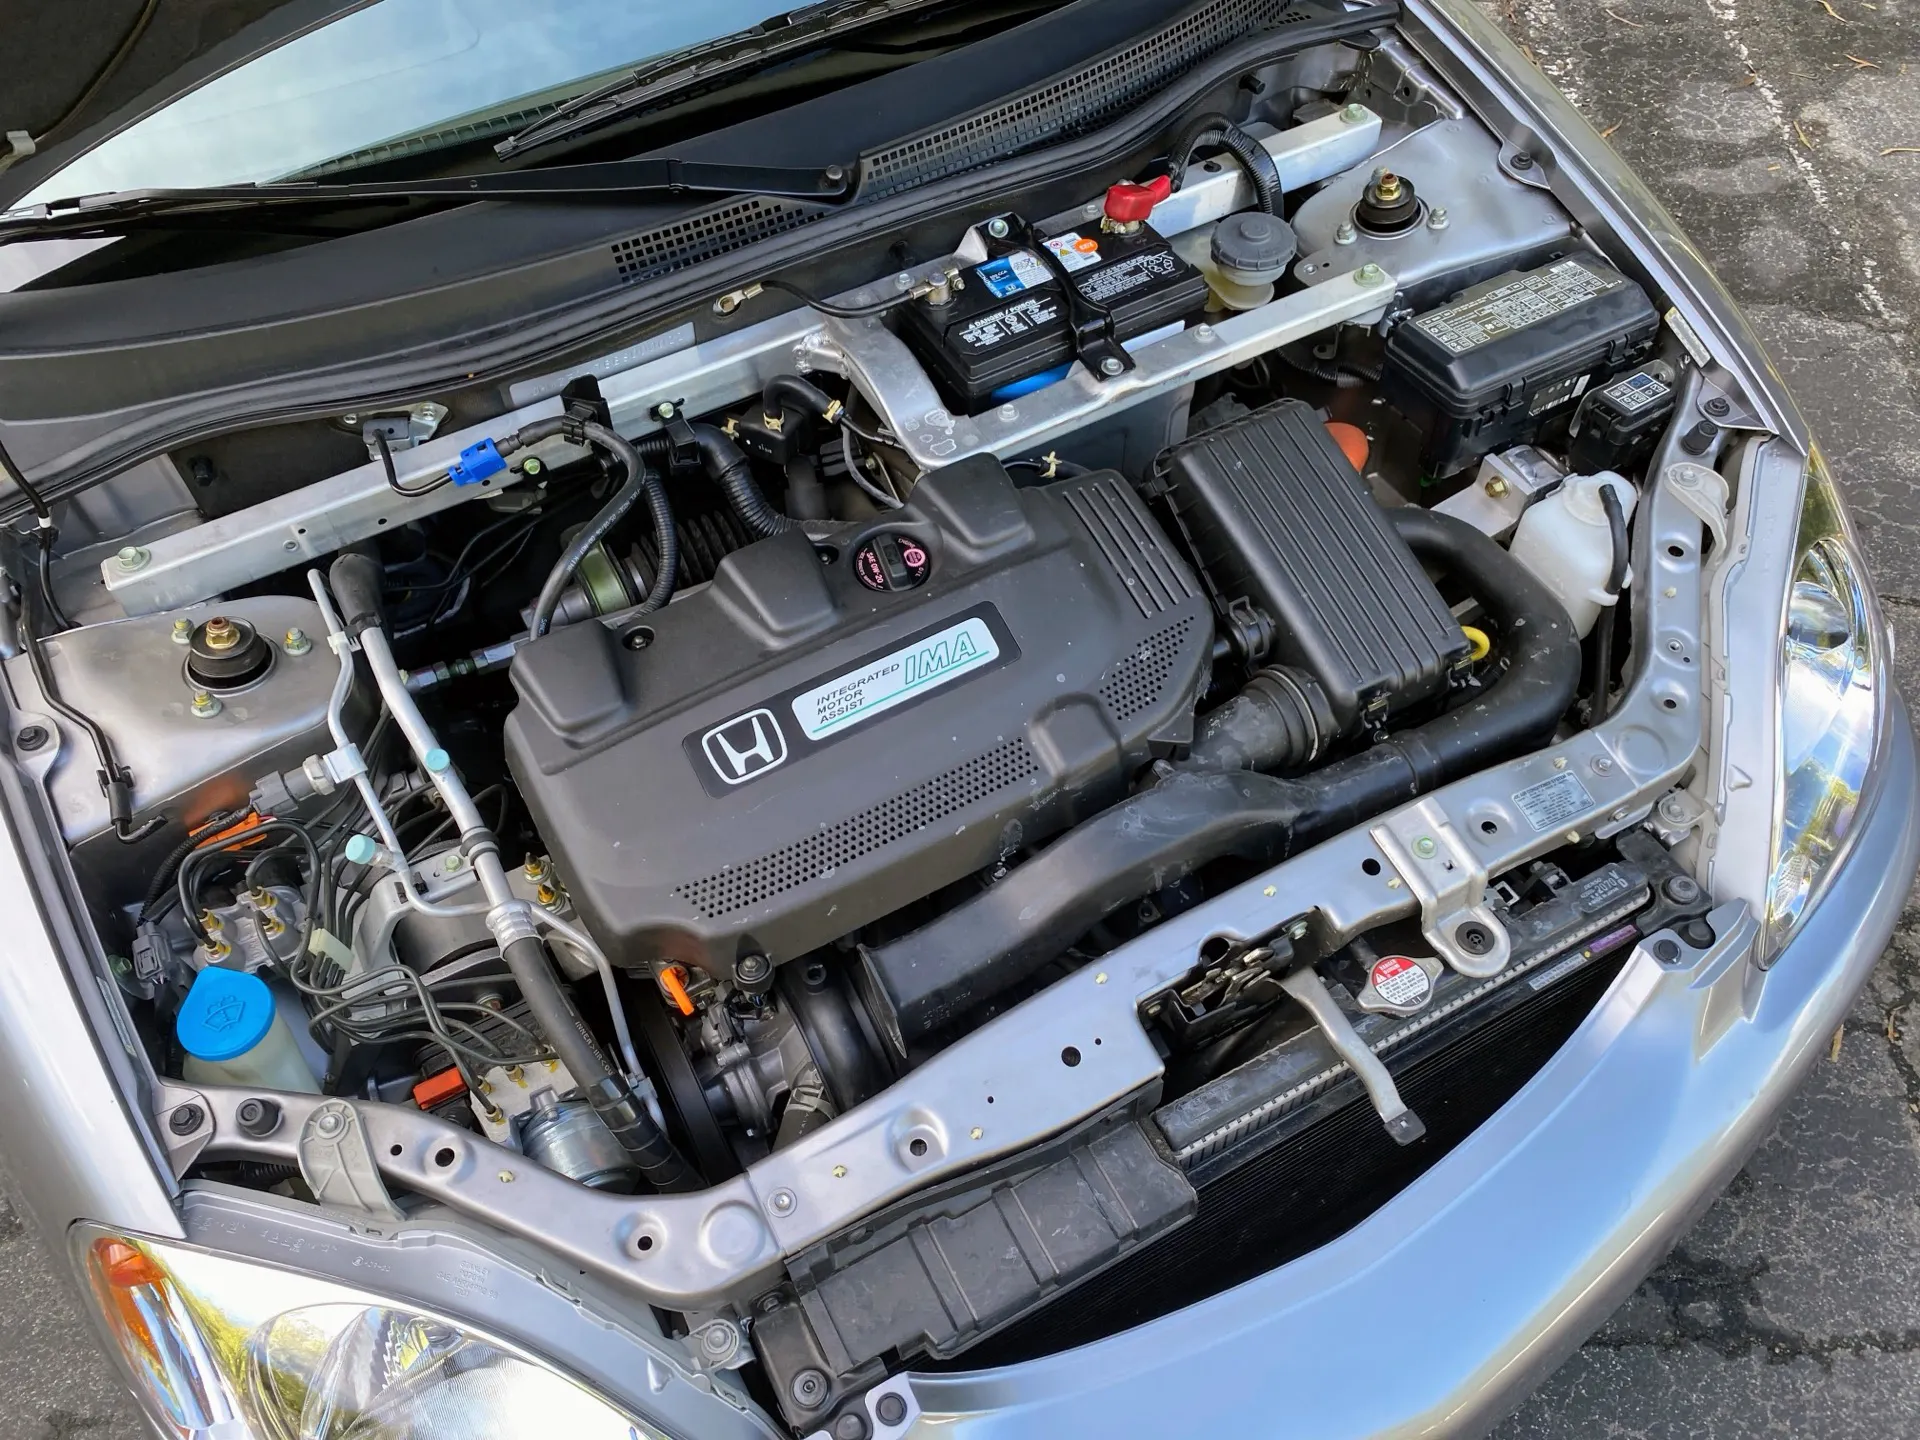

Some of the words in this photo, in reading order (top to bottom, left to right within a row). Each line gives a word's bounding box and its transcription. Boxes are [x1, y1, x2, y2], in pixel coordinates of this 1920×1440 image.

[974, 312, 1005, 327] DANGER
[1009, 299, 1036, 313] POISON
[866, 552, 877, 564] SAE
[870, 563, 884, 584] 0W-20
[905, 631, 976, 685] IMA
[816, 663, 899, 706] INTEGRATED
[817, 689, 863, 716] MOTOR
[820, 697, 865, 724] ASSIST
[1594, 878, 1617, 894] 2070
[1608, 870, 1619, 880] V
